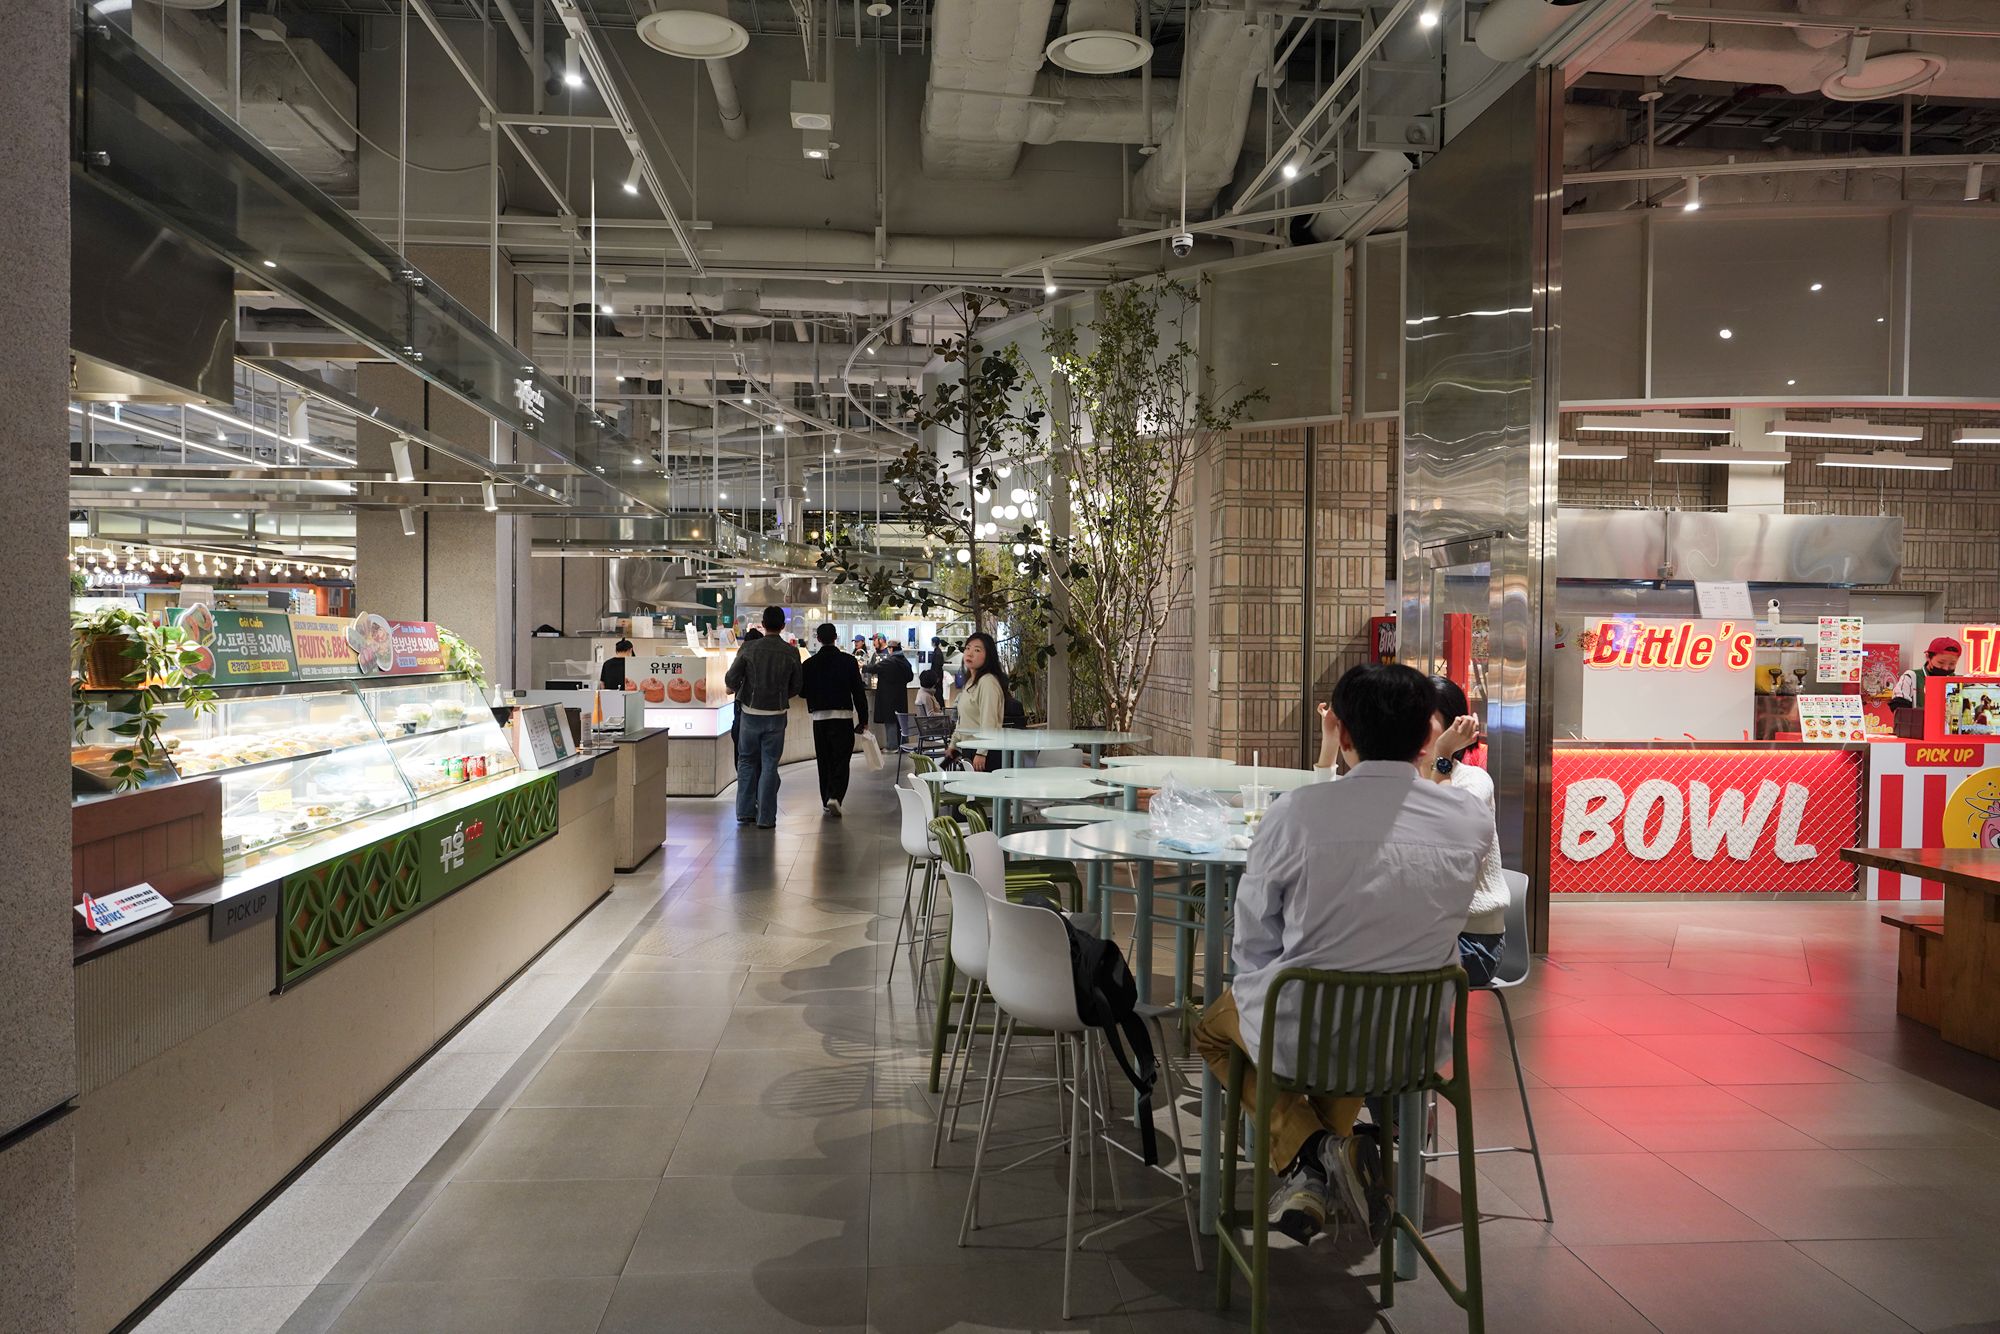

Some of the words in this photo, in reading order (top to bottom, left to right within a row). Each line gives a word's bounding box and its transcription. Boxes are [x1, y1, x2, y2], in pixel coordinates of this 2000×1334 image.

[97, 570, 148, 587] foodie
[217, 632, 259, 656] 스프링롤
[296, 634, 326, 659] FRUITS
[1589, 619, 1756, 671] Bittle's
[1916, 747, 1951, 763] PICK
[1953, 748, 1975, 762] UP
[1559, 777, 1818, 864] BOWL
[91, 902, 109, 915] SELF
[227, 905, 250, 926] PICK
[253, 895, 267, 914] UP
